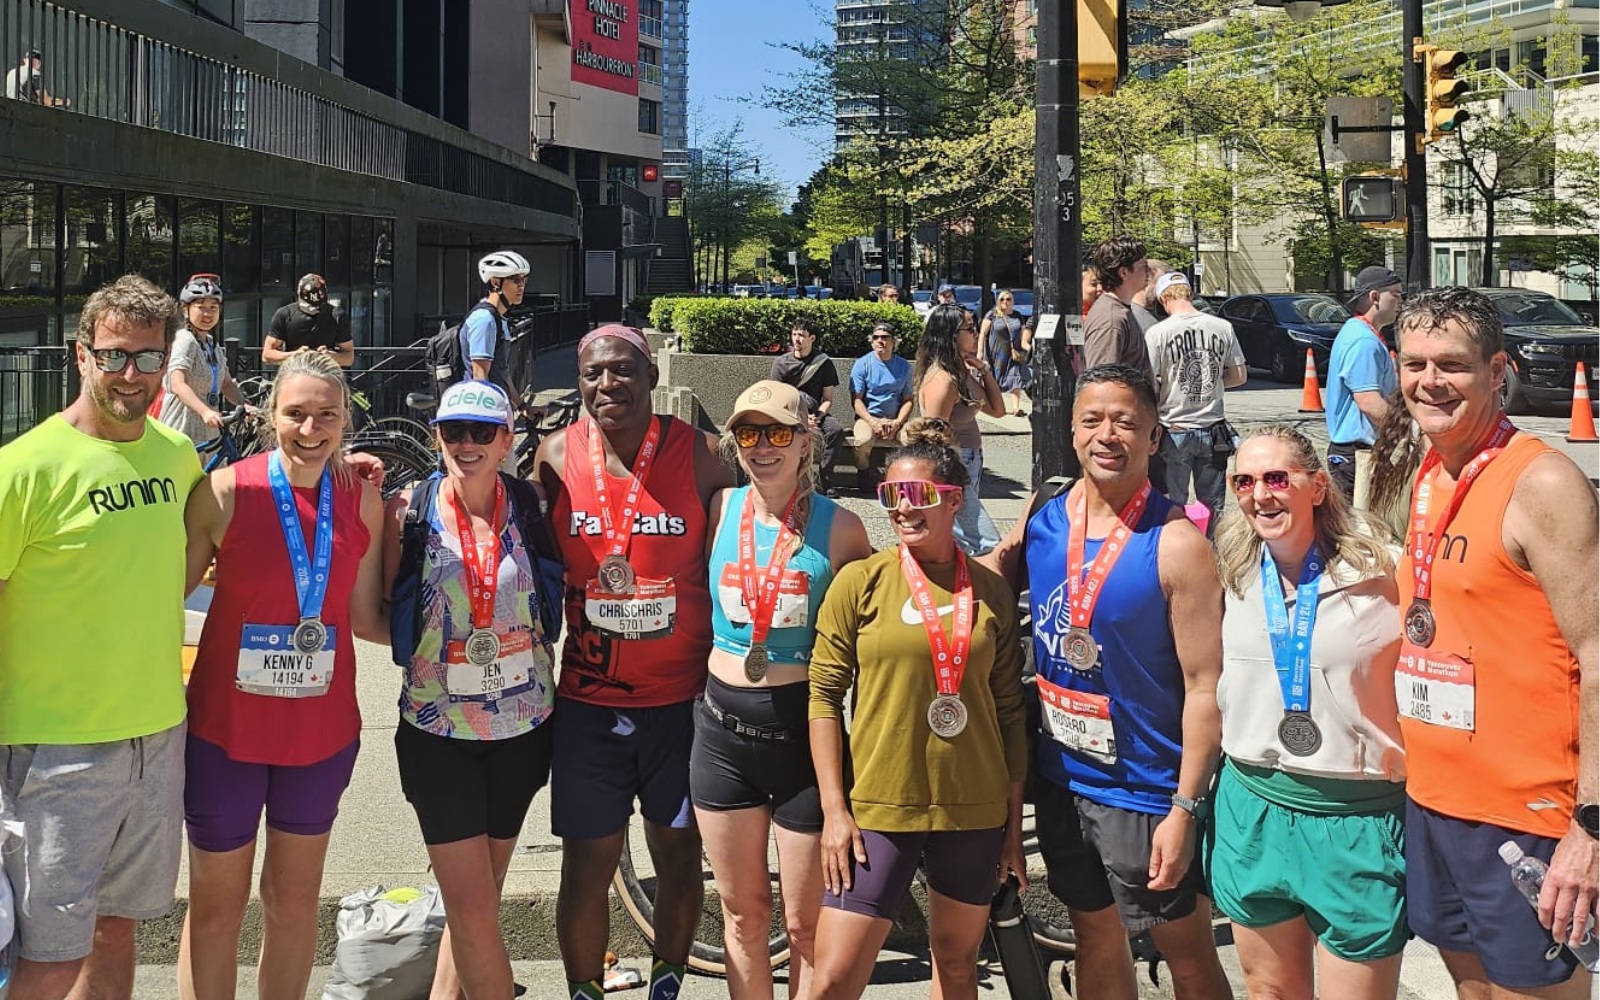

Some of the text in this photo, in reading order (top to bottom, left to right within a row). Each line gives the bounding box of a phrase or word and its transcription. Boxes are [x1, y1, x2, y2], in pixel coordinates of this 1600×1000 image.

[588, 0, 628, 23] PINNACLE
[595, 16, 621, 40] HOTEL
[576, 48, 636, 78] HARBOURFRONT
[1062, 207, 1070, 221] 3
[447, 388, 496, 409] ciele
[570, 511, 603, 535] Fa
[599, 602, 662, 618] CHRISCHRIS
[619, 619, 643, 631] 5701
[263, 654, 314, 670] KENNY G
[482, 662, 502, 678] JEN
[272, 671, 304, 684] 14194
[480, 676, 506, 692] 3290
[1412, 681, 1428, 702] KIM
[1410, 701, 1432, 720] 2485
